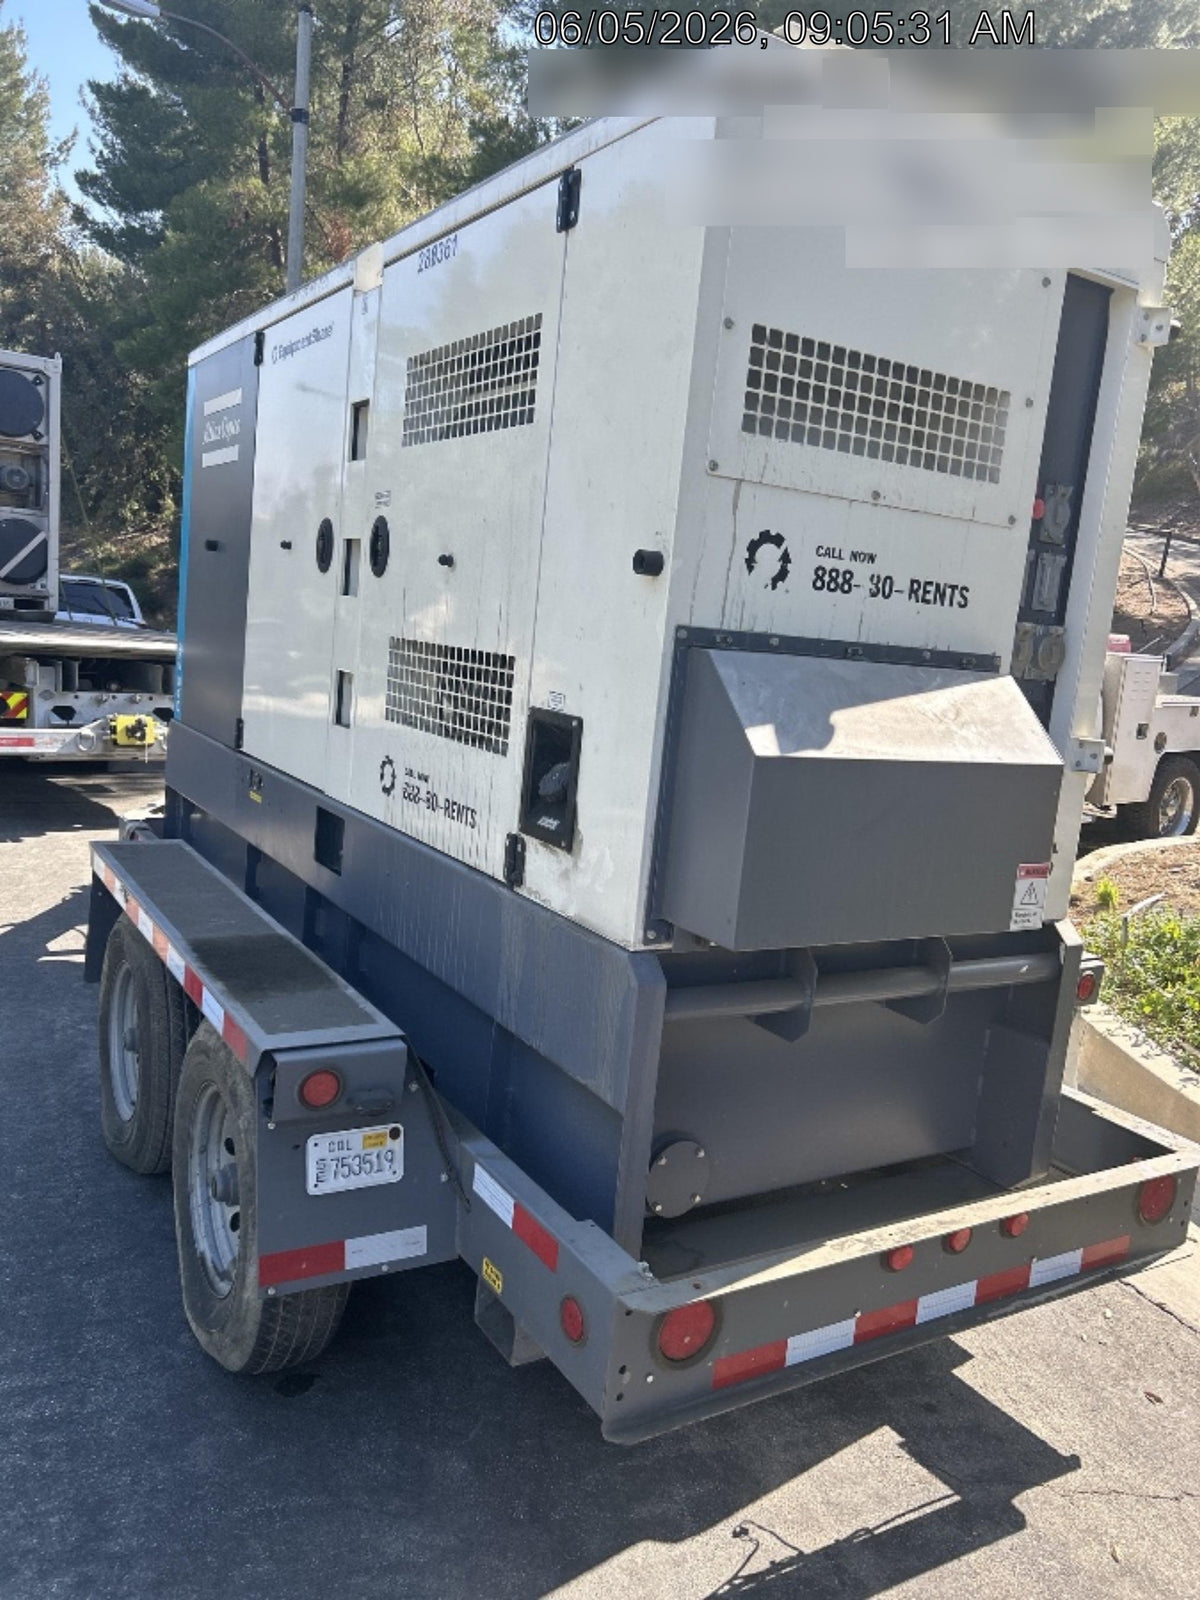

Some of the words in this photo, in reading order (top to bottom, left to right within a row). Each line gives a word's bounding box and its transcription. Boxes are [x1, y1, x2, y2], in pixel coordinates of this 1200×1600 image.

[815, 545, 845, 561] CALL
[849, 550, 877, 564] NOW
[328, 1139, 353, 1152] CAL
[330, 1149, 394, 1179] 753519
